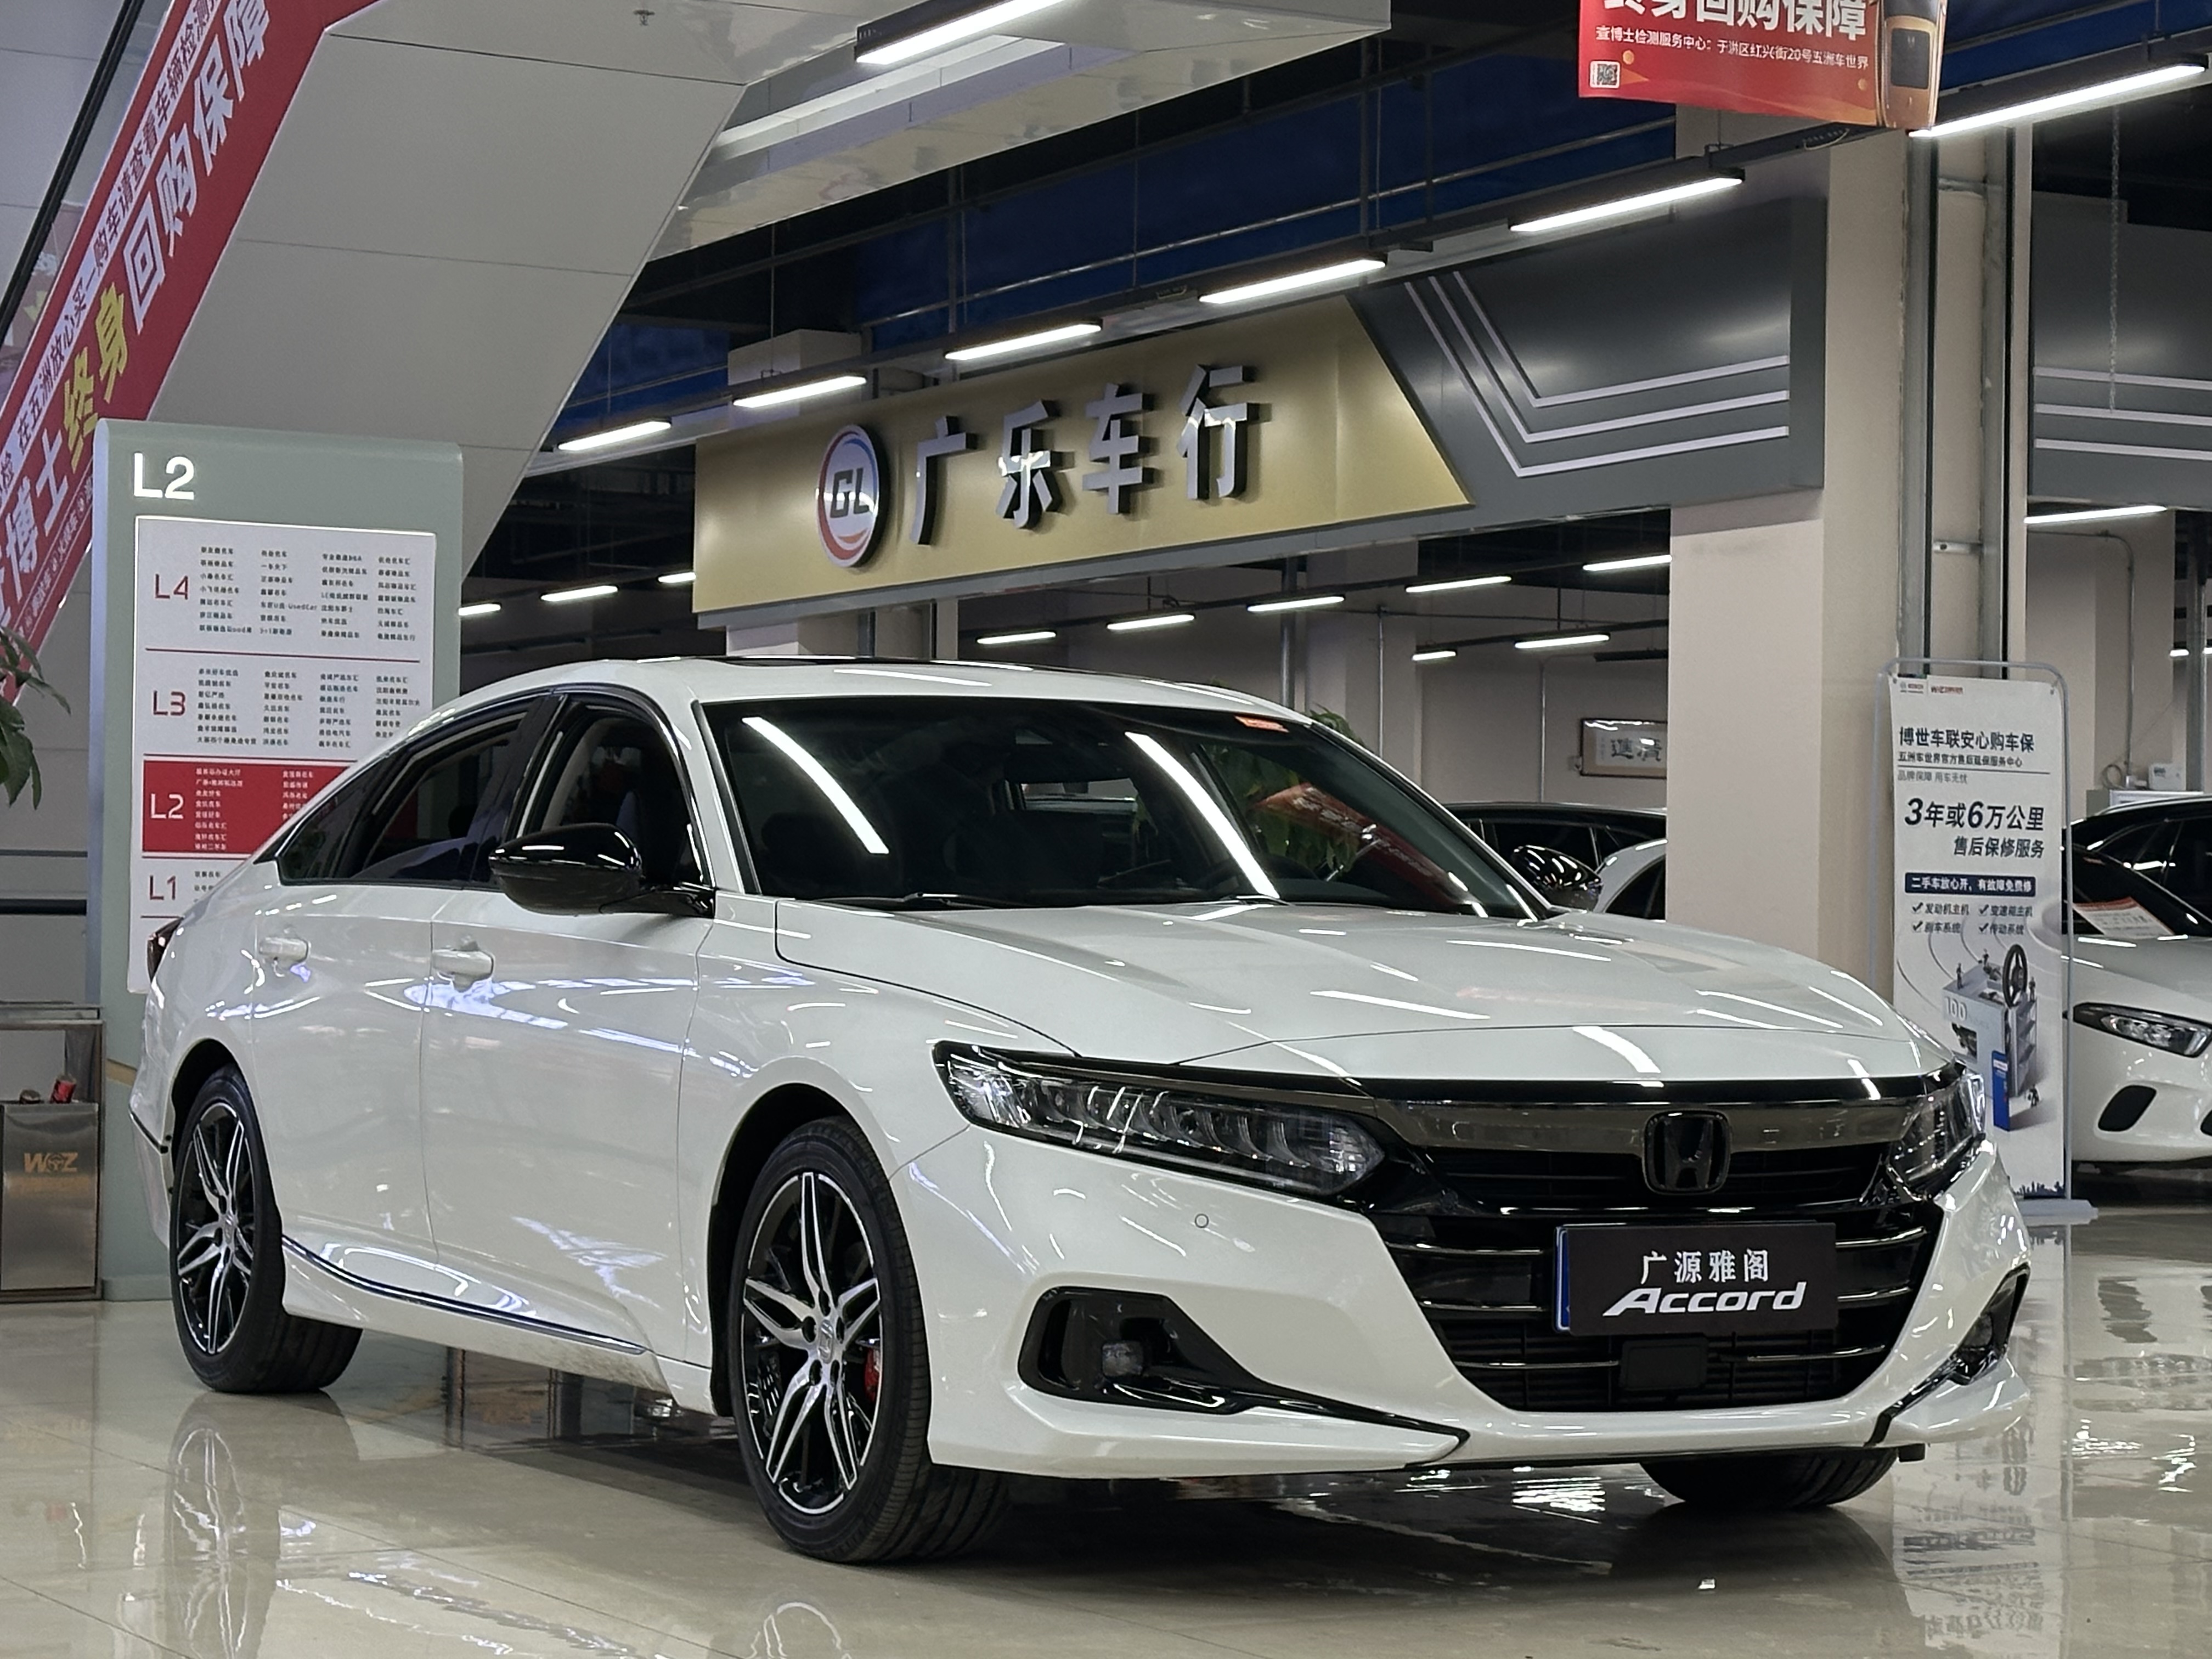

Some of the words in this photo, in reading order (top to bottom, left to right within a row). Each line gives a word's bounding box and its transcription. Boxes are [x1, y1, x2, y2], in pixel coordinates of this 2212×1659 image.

[909, 364, 1252, 546] 广乐车行
[133, 453, 196, 500] L2
[154, 573, 189, 600] L4
[153, 690, 185, 716] L3
[1899, 726, 2035, 753] 博世车联安心购车保
[150, 794, 184, 820] L2
[1904, 798, 2045, 831] 3年或6万公里
[1953, 836, 2045, 859] 售后保修服务
[149, 876, 176, 900] L1
[1640, 1249, 1769, 1285] 广源雅阁
[1602, 1281, 1807, 1317] Accord
